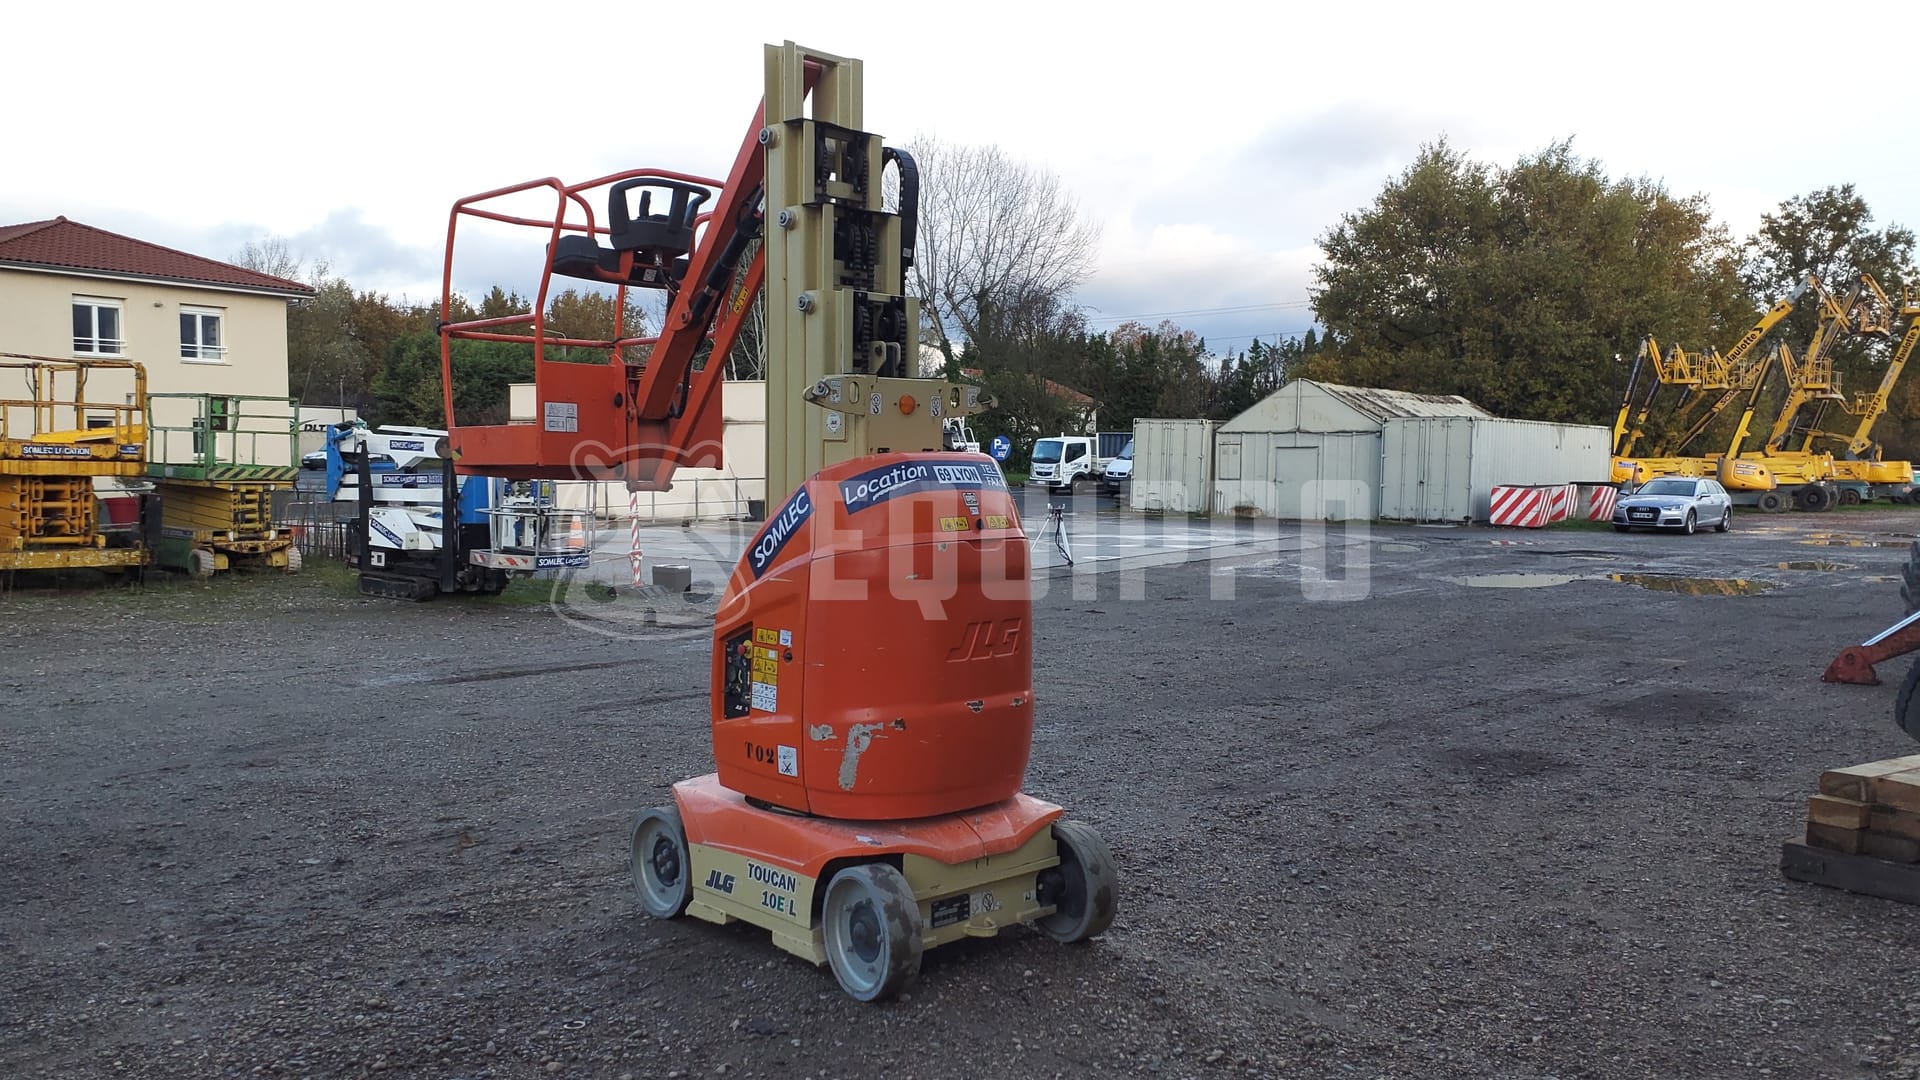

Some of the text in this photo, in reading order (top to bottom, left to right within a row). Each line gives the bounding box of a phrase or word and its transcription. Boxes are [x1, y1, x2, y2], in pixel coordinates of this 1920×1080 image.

[1895, 331, 1916, 363] Haulotte
[303, 424, 327, 432] DLT
[844, 464, 979, 505] Location 69 LYON
[756, 491, 810, 568] SOMLEC
[538, 557, 565, 566] SOMLEC
[945, 617, 1021, 662] JLG
[705, 869, 736, 894] JLG
[747, 862, 797, 893] TOUCAN
[761, 890, 797, 917] 10E L
